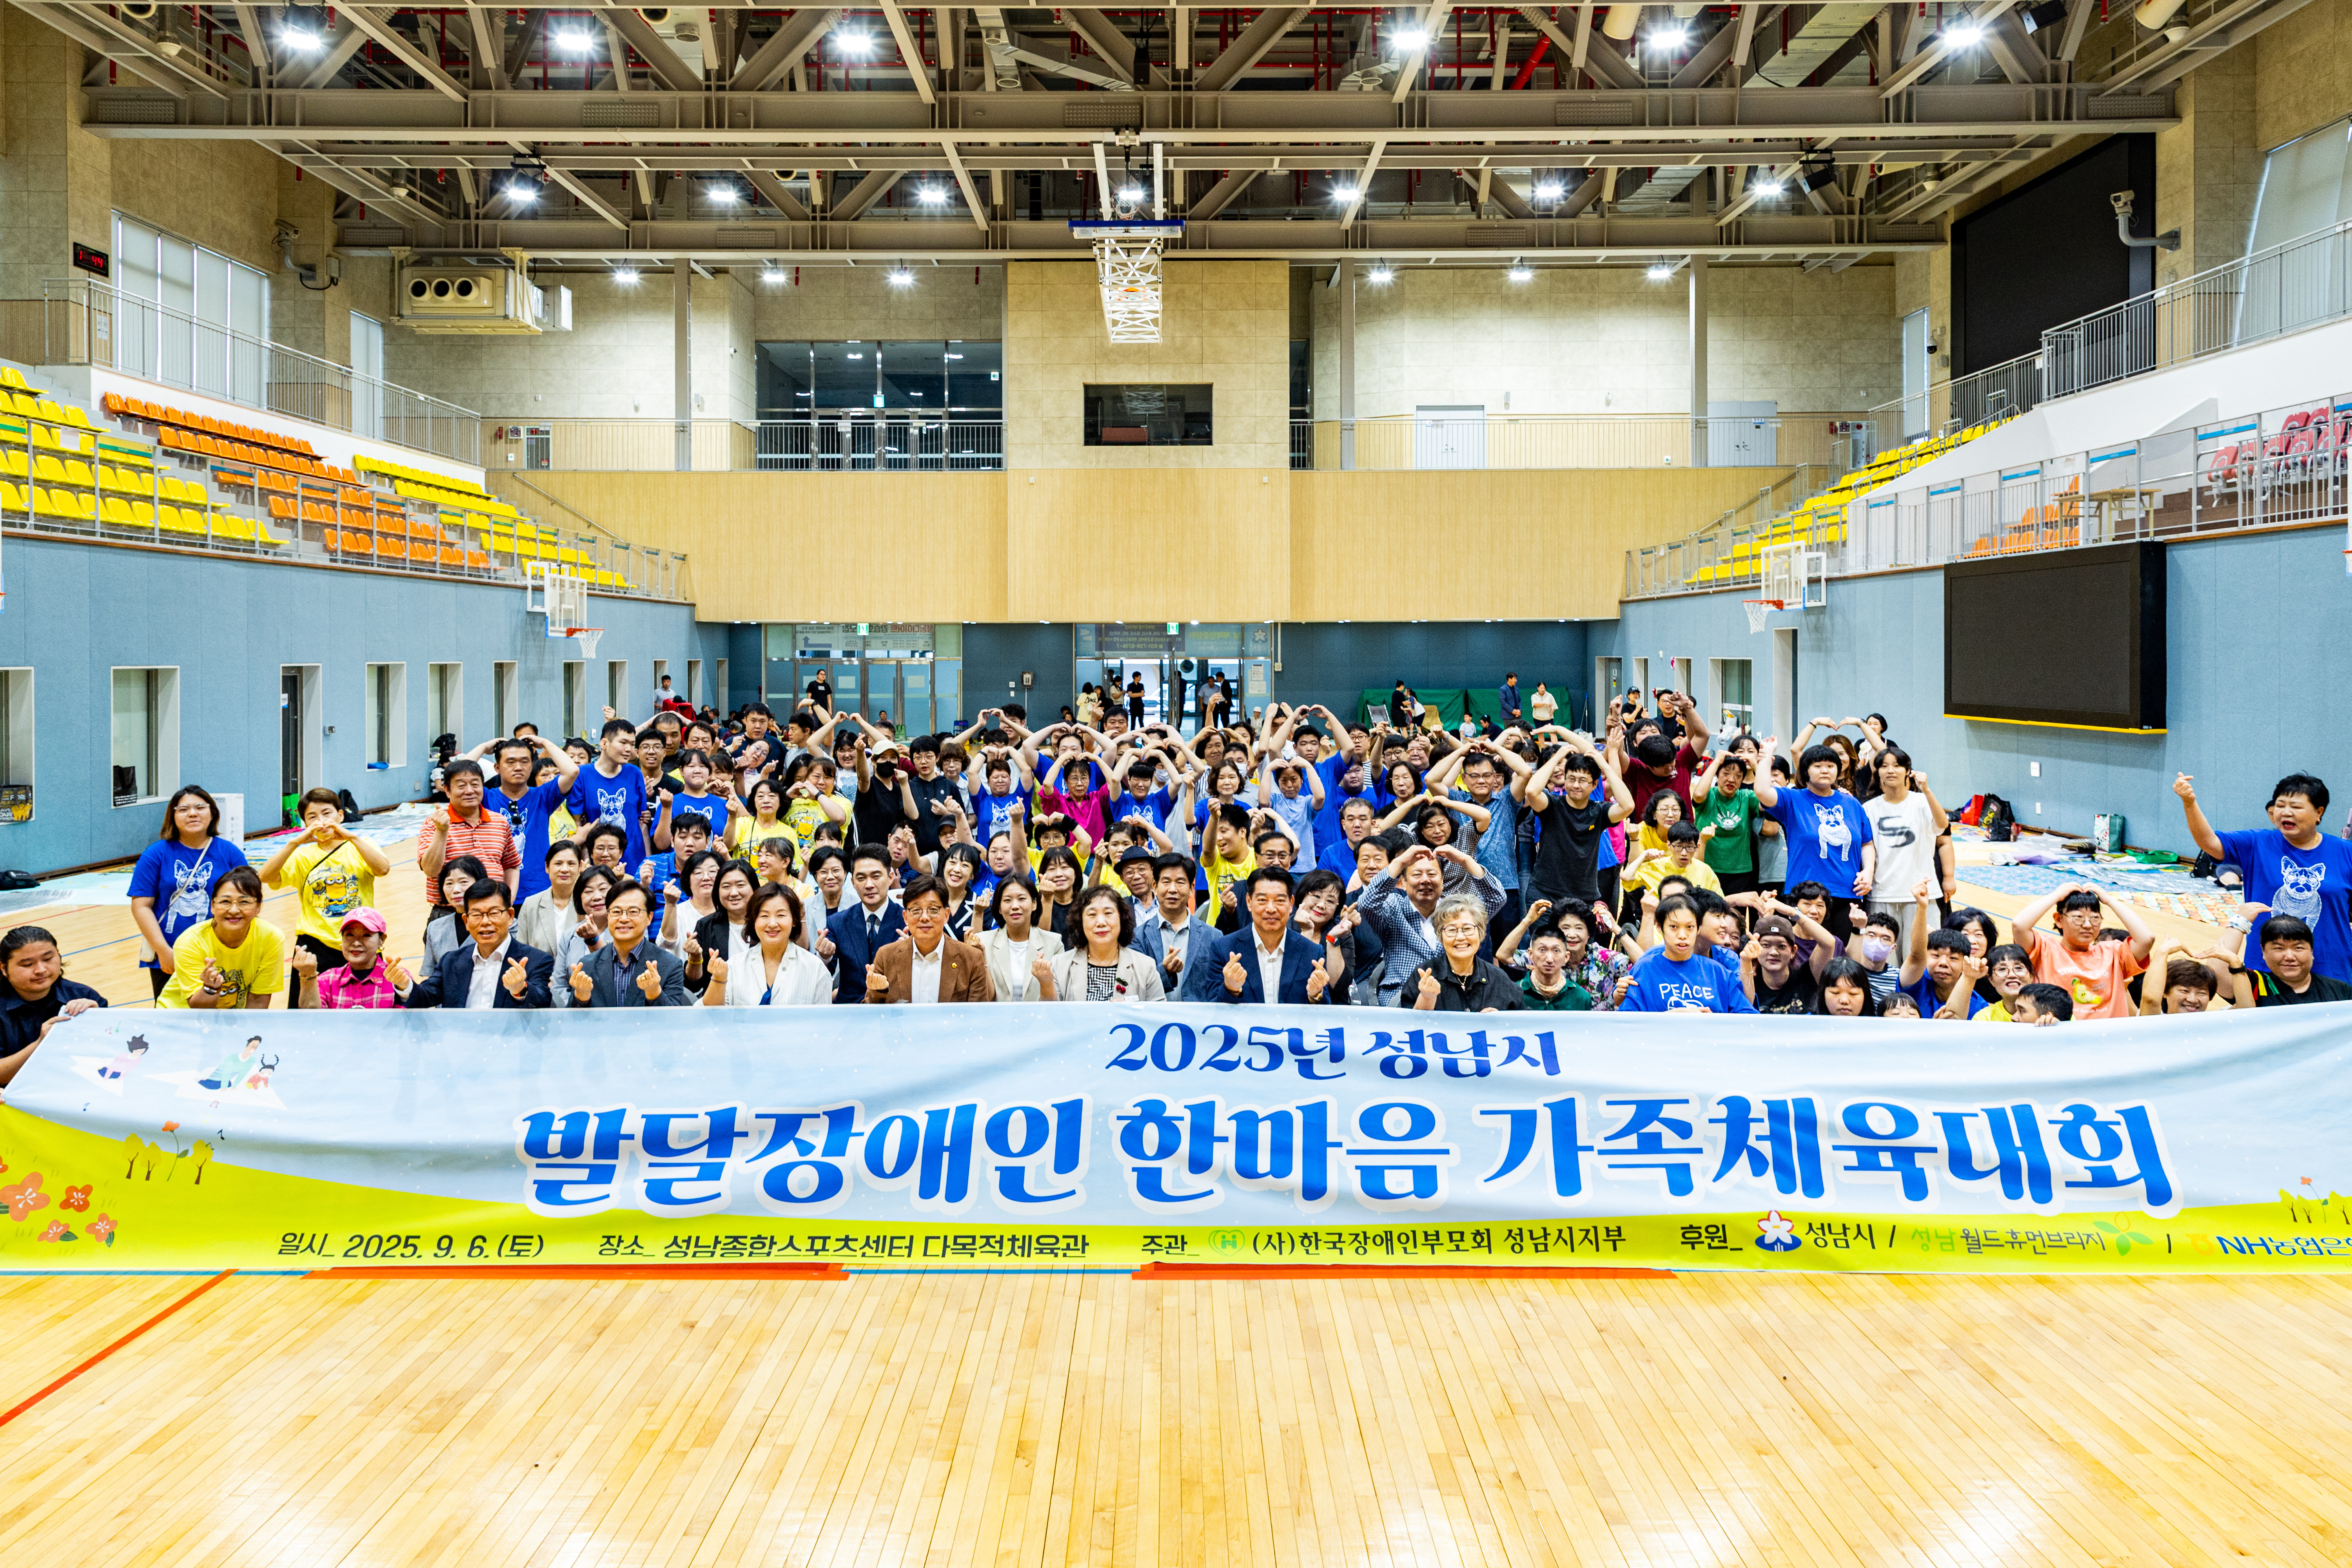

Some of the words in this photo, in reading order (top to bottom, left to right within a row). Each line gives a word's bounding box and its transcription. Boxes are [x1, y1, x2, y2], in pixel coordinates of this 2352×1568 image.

[1659, 983, 1714, 999] PEACE
[1105, 1023, 1346, 1080] 2025년
[1362, 1029, 1561, 1079] 성남시
[523, 1098, 1083, 1205] 발달장애인
[1116, 1099, 1450, 1202] 한마음
[1480, 1096, 2172, 1206] 가족체육대회
[278, 1233, 334, 1257] 일시_
[343, 1234, 422, 1258] 2025.
[434, 1235, 456, 1258] 9.
[599, 1235, 655, 1257] 장소_
[664, 1234, 914, 1258] 성남종합스포츠센터
[923, 1234, 1089, 1258] 다목적체육관
[1141, 1235, 1200, 1256] 주관_
[1253, 1228, 1492, 1255] (사)한국장애인부모회
[1504, 1225, 1626, 1254] 성남시지부
[1681, 1224, 1743, 1251] 후원_
[1806, 1223, 1875, 1249] 성남시
